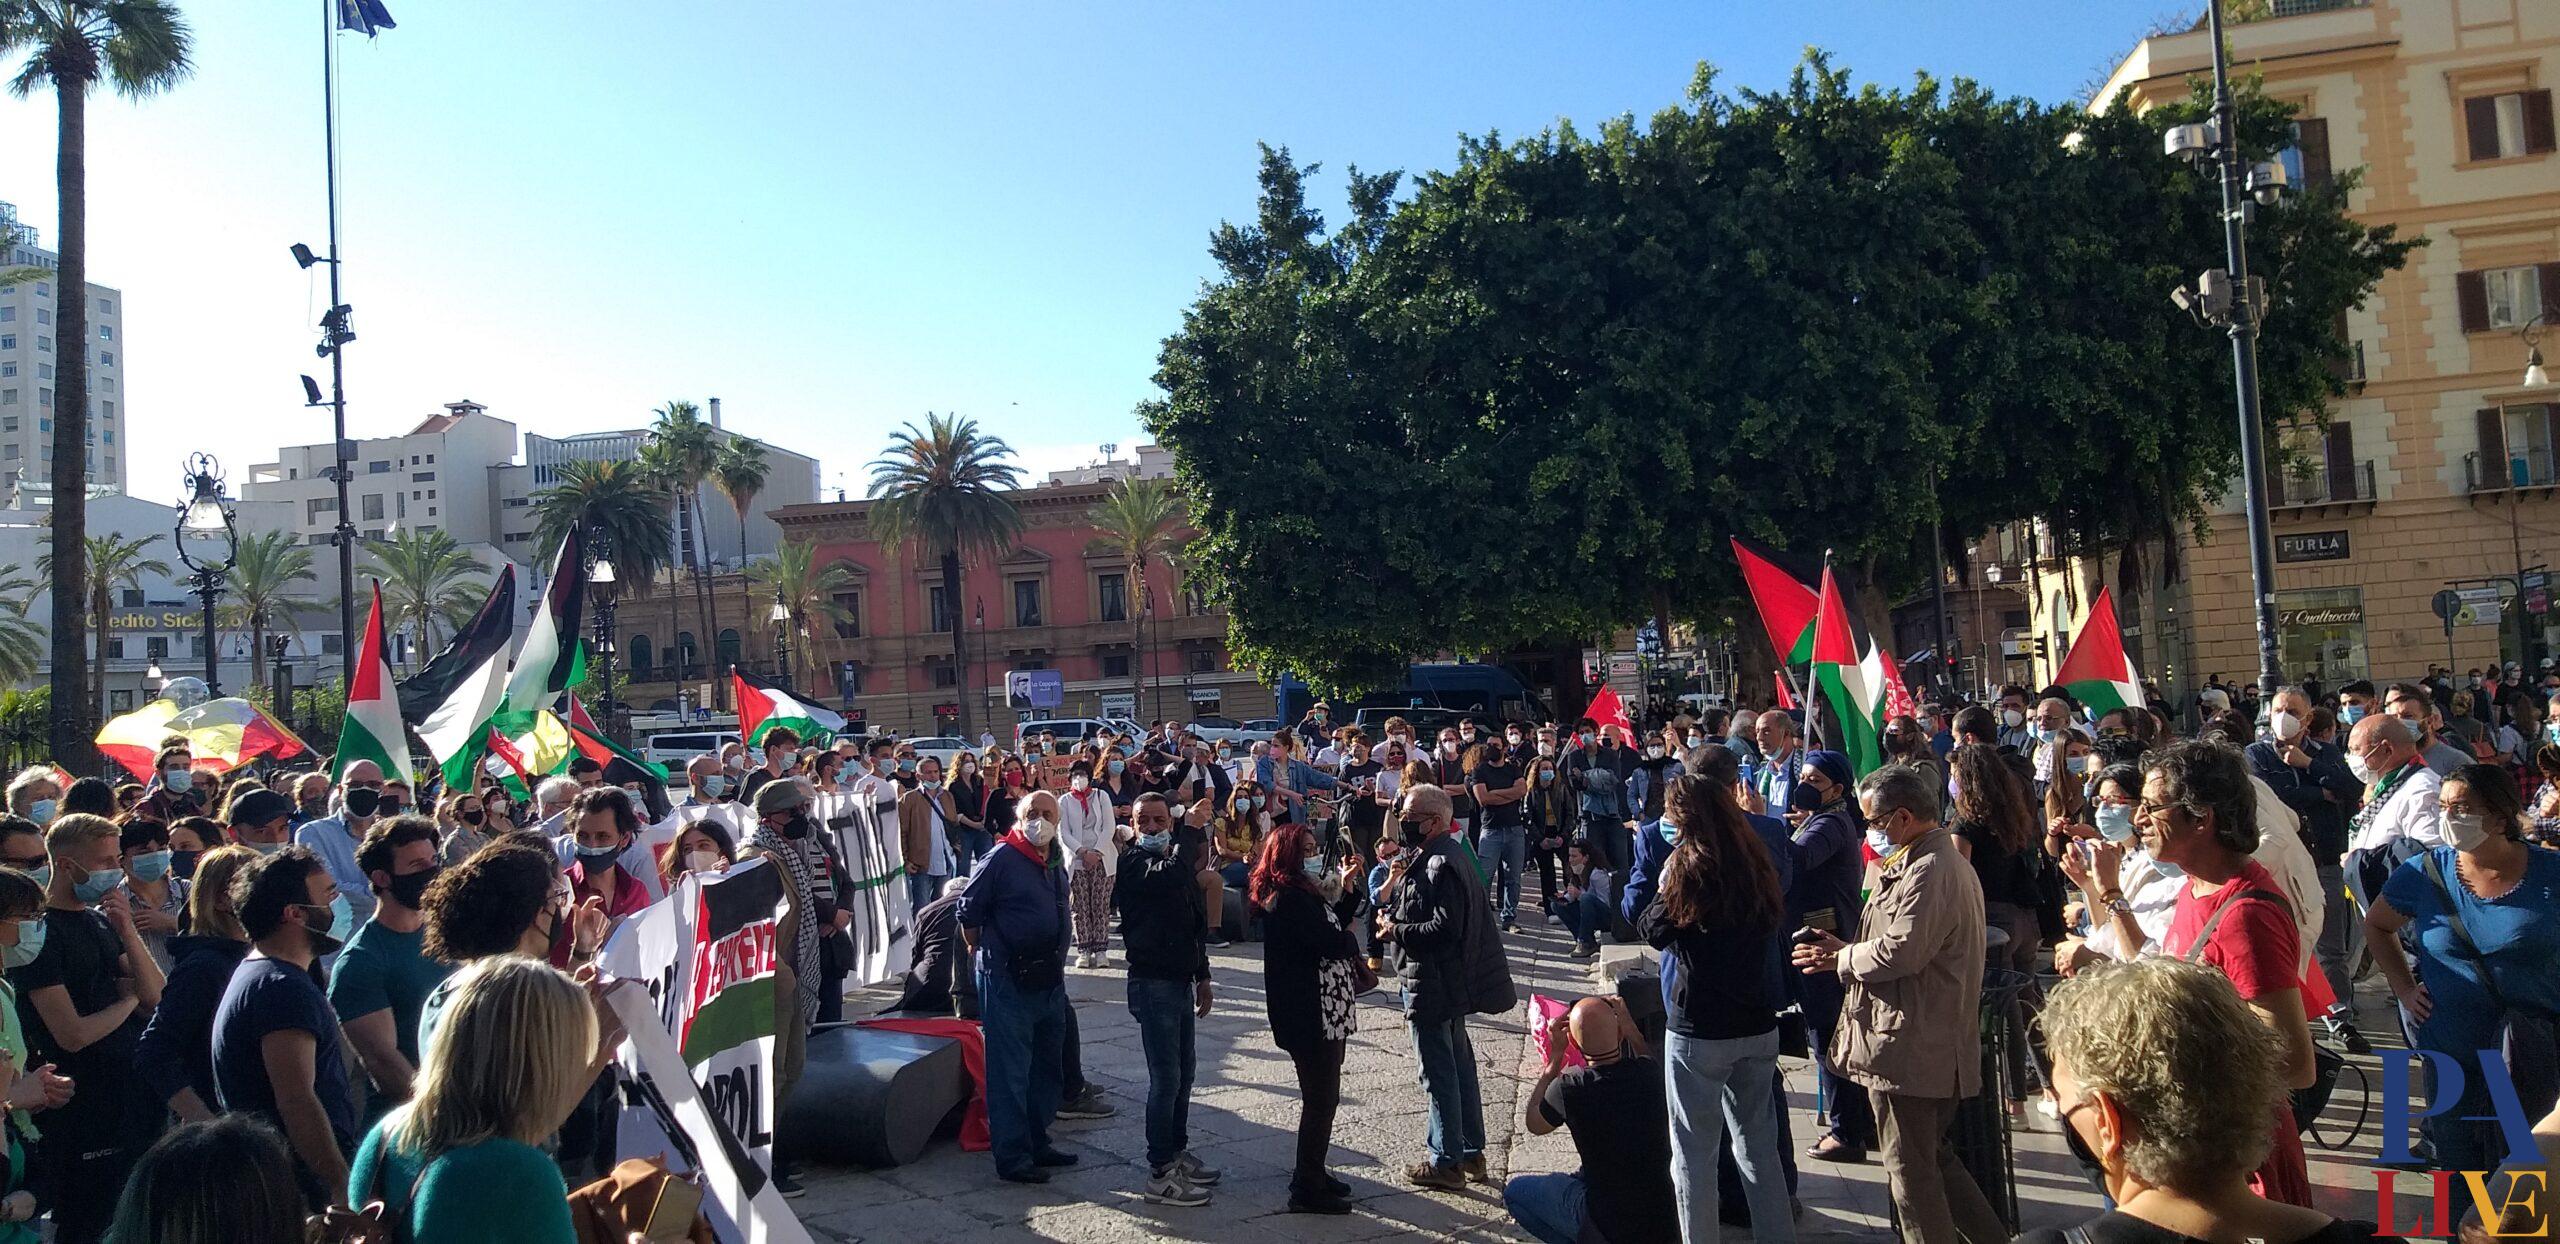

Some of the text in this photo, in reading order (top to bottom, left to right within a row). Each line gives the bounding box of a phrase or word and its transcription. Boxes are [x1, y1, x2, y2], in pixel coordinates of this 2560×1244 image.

[2283, 537, 2340, 552] FURLA
[86, 612, 157, 629] Cedito
[2295, 607, 2361, 625] Quattrocchi
